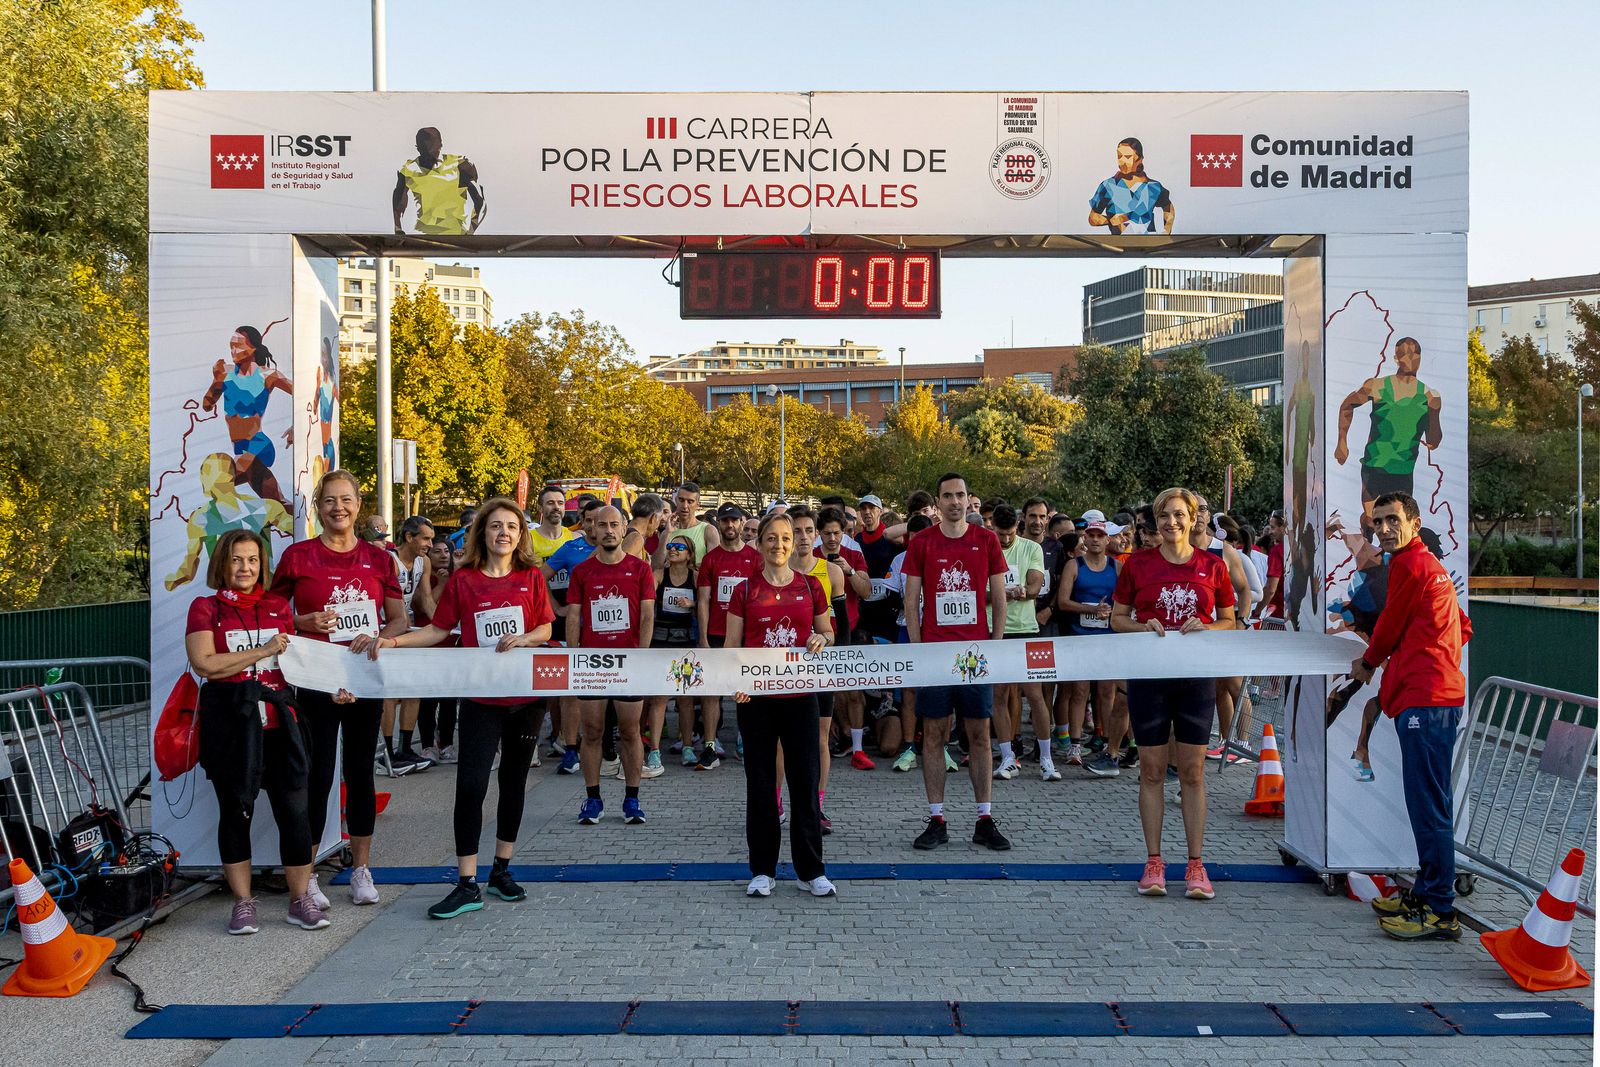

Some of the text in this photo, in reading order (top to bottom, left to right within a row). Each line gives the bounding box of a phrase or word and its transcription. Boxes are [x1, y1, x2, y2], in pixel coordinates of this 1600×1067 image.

[647, 118, 832, 140] III CARRERA
[272, 135, 351, 157] IRSST
[1251, 134, 1413, 156] Comunidad
[542, 140, 946, 172] POR LA PREVENCIÓN DE
[992, 141, 1048, 168] PLAN REGIONAL CONTRA LAS
[1006, 154, 1036, 168] DRO
[306, 162, 340, 170] Regional
[284, 172, 322, 180] Seguridad
[1005, 169, 1034, 182] GAS
[1251, 165, 1411, 189] de Madrid
[293, 182, 320, 190] Trabajo
[571, 184, 918, 208] RIESGOS LABORALES
[814, 256, 931, 310] 0:00
[598, 609, 623, 622] 0012
[944, 602, 970, 615] 0016
[336, 614, 369, 630] 0004
[485, 620, 517, 637] 0003
[574, 654, 627, 668] IRSST
[786, 650, 864, 662] III CARRERA
[741, 660, 914, 676] POR LA PREVENCIÓN DE
[753, 676, 902, 691] RIESGOS LABORALES
